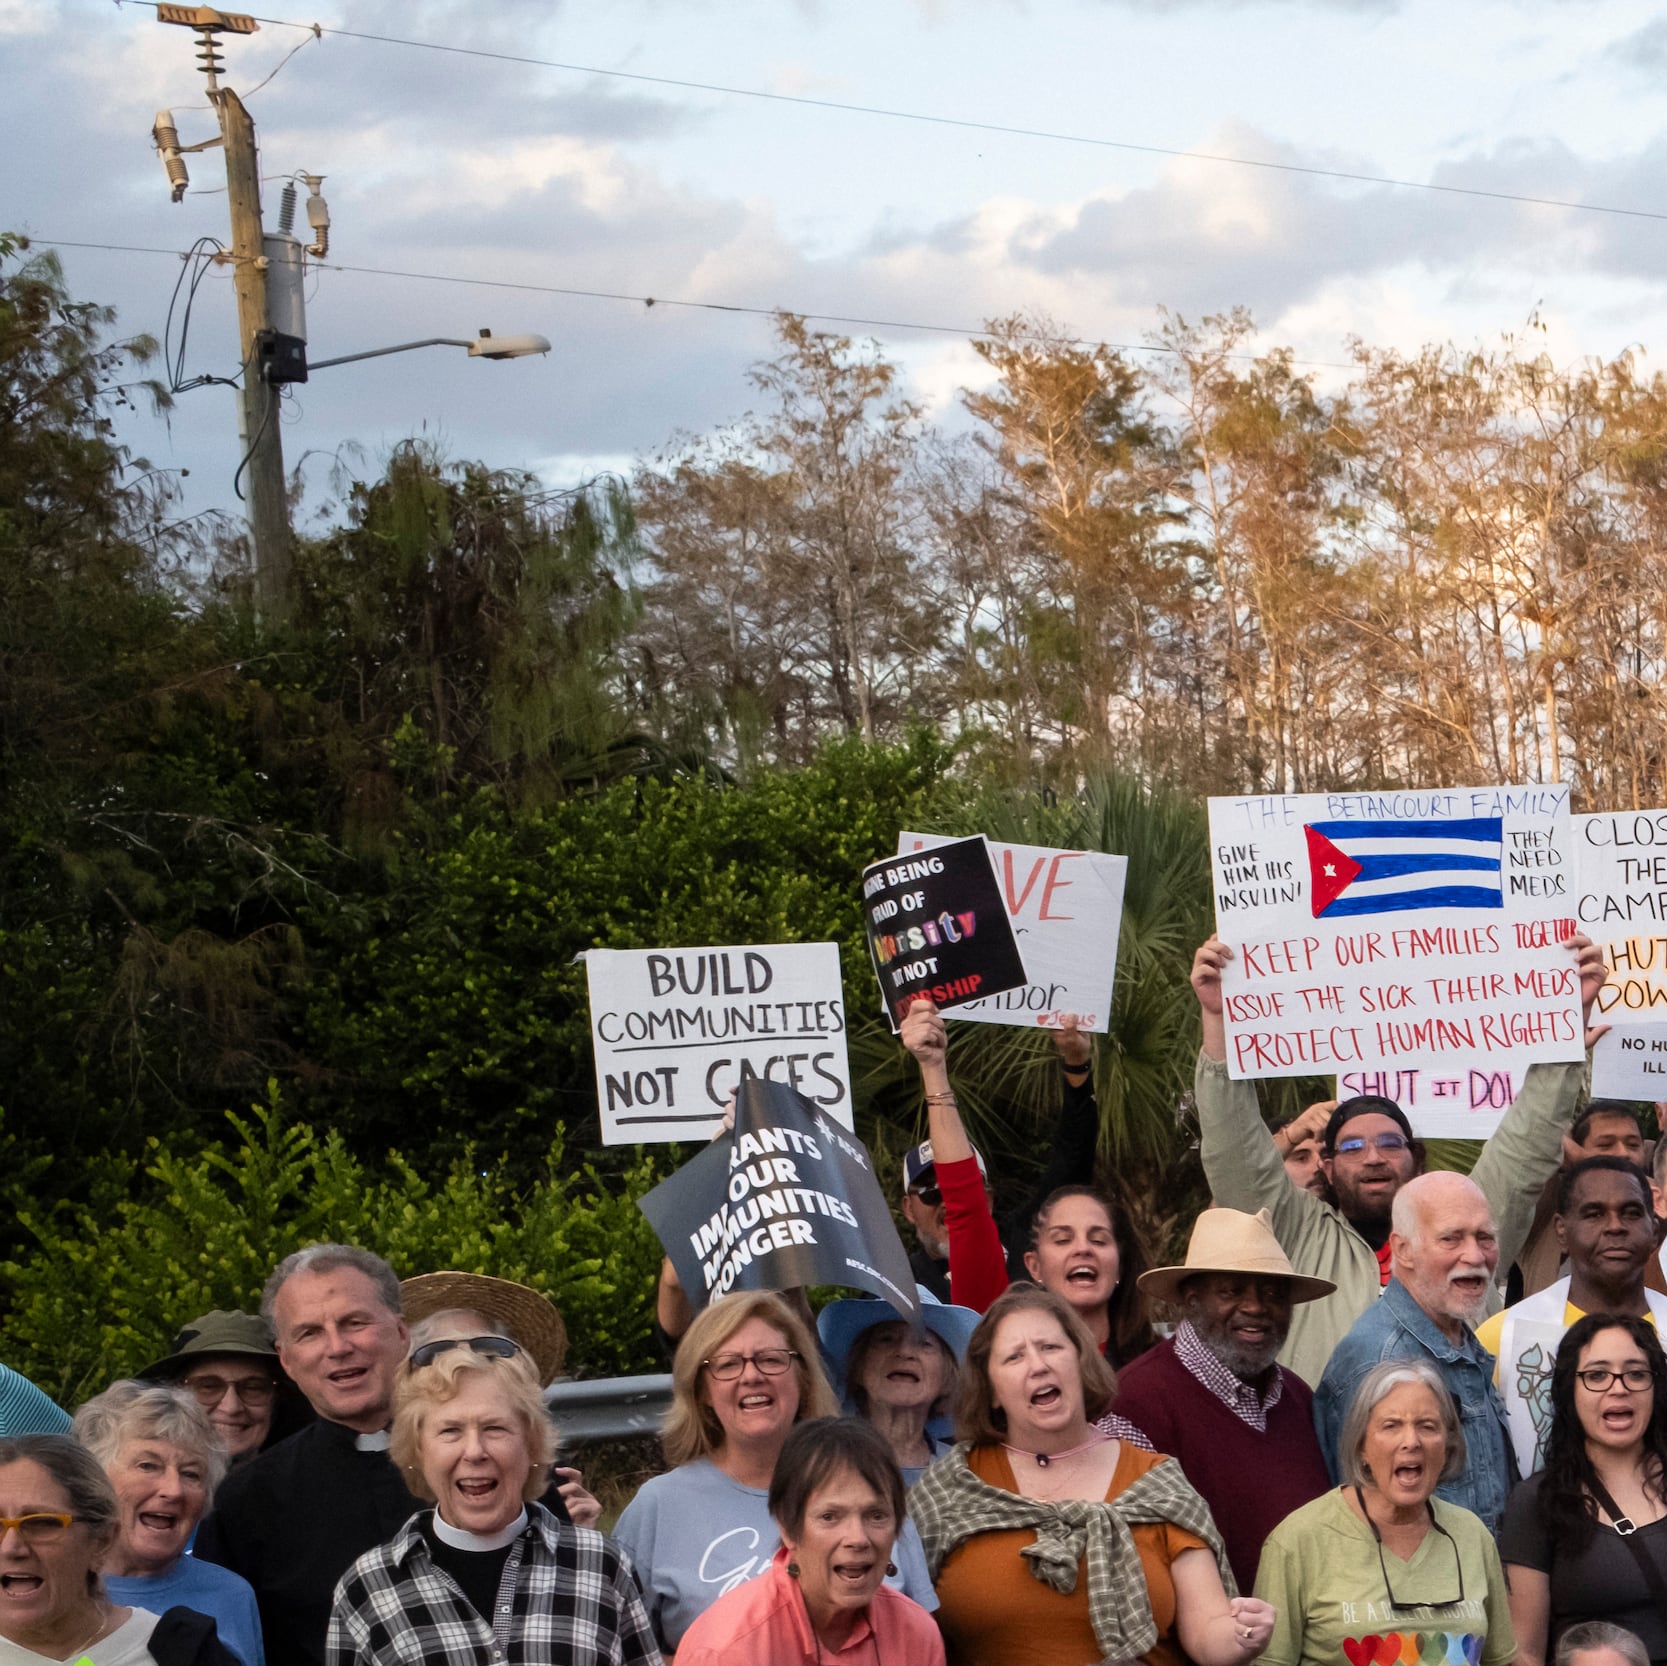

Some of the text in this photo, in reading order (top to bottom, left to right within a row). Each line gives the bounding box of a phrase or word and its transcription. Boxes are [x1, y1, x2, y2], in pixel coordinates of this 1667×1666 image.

[1236, 790, 1570, 831] THE BETANCOURT FAMILY
[1218, 843, 1261, 862] GIVE
[1507, 826, 1554, 849] THEY
[888, 857, 945, 887] BEING
[1223, 861, 1293, 884] HIM HIS
[1509, 848, 1562, 868] NEED
[1219, 881, 1302, 912] INSULIN!
[1510, 874, 1566, 898] MEDS
[900, 891, 925, 912] OF
[1242, 924, 1500, 980] KEEP OUR FAMILIES
[646, 952, 773, 998] BUILD
[904, 957, 938, 981] NOT
[1224, 968, 1576, 1023] ISSUE THE SICK THEIR MEDS
[598, 1000, 844, 1044] COMMUNITIES
[1234, 1009, 1579, 1073] PROTECT HUMAN RIGHTS
[1621, 1037, 1645, 1050] NO
[605, 1066, 678, 1111] NOT
[1341, 1070, 1461, 1105] SHUT IT
[729, 1158, 801, 1203] OUR
[1342, 1601, 1378, 1624] BE A
